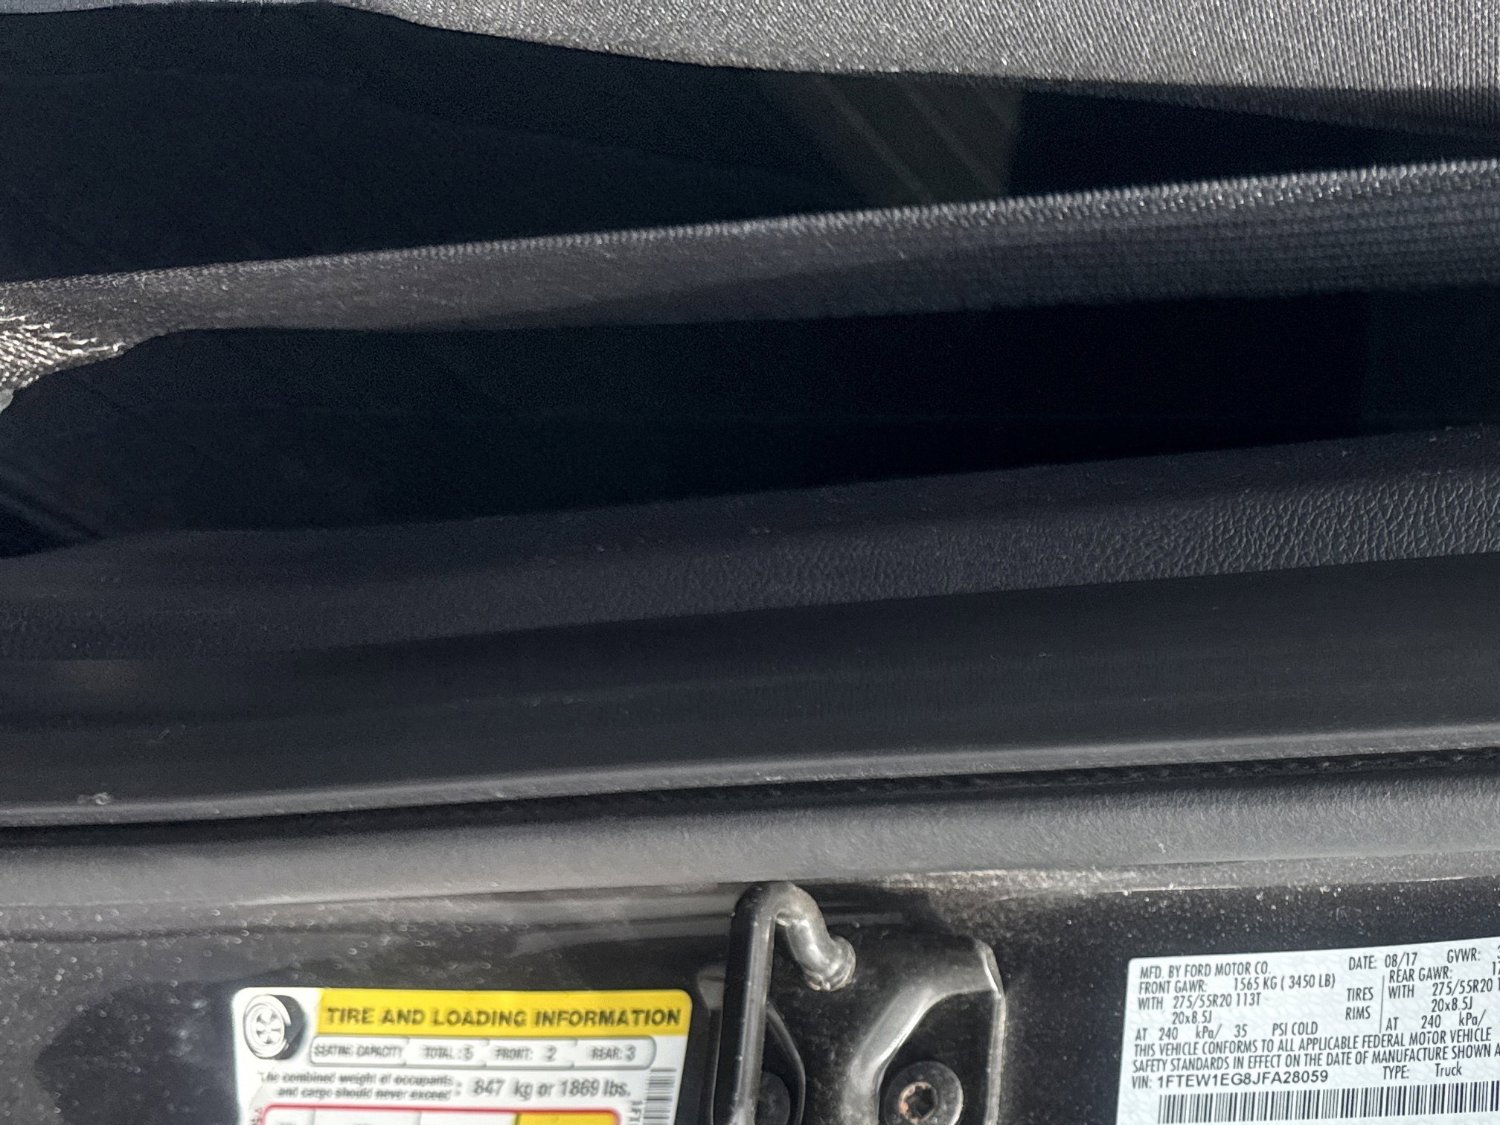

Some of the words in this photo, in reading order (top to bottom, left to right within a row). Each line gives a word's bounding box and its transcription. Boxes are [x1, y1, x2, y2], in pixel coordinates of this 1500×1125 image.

[1348, 954, 1376, 970] DATE:
[1384, 951, 1418, 968] 08/17
[1446, 947, 1480, 963] GVWR:
[1139, 965, 1164, 979] MFD.
[1167, 964, 1181, 978] BY
[1183, 962, 1211, 977] FORD
[1214, 961, 1251, 976] MOTOR
[1254, 960, 1270, 975] CO.
[1388, 966, 1414, 983] REAR
[1418, 965, 1452, 981] GAWR:
[1138, 981, 1171, 995] FRONT
[1174, 979, 1207, 993] GAWR:
[1234, 976, 1259, 991] 1565
[1262, 975, 1277, 990] KG
[1387, 983, 1414, 999] WITH
[1432, 977, 1493, 996] 275/55R20
[1137, 996, 1163, 1010] WITH
[1172, 992, 1232, 1009] 275/55R20
[1236, 991, 1261, 1006] 113T
[1430, 995, 1473, 1012] 20x8.5J
[325, 1007, 374, 1024] TIRE
[380, 1008, 425, 1025] AND
[431, 1009, 526, 1026] LOADING
[533, 1008, 681, 1027] INFORMATION
[1171, 1009, 1212, 1025] 20x8.5J
[1134, 1027, 1148, 1041] AT
[1158, 1026, 1178, 1041] 240
[1233, 1023, 1248, 1038] 35
[1271, 1022, 1288, 1036] PSI
[1291, 1020, 1318, 1036] COLD
[1133, 1043, 1155, 1057] THIS
[1158, 1041, 1199, 1056] VEHICLE
[1201, 1039, 1257, 1055] CONFORMS
[1261, 1038, 1274, 1052] TO
[1277, 1038, 1295, 1052] ALL
[1298, 1034, 1359, 1051] APPLICABLE
[1361, 1032, 1405, 1048] FEDERAL
[1408, 1029, 1446, 1046] MOTOR
[1449, 1026, 1492, 1043] VEHICLE
[1132, 1058, 1167, 1073] SAFETY
[1170, 1055, 1229, 1072] STANDARDS
[1232, 1055, 1244, 1069] IN
[1247, 1053, 1281, 1069] EFFECT
[1284, 1053, 1300, 1067] ON
[1303, 1052, 1323, 1066] THE
[1325, 1050, 1352, 1066] DATE
[1354, 1050, 1368, 1064] OF
[1371, 1045, 1449, 1064] MANUFACTURE
[1451, 1042, 1491, 1059] SHOWN
[1131, 1076, 1151, 1088] VIN:
[1157, 1069, 1328, 1088] 1FTEW1EG8JFA28059
[1382, 1064, 1409, 1080] TYPE:
[1434, 1061, 1462, 1077] Truck
[511, 1079, 533, 1098] kg
[535, 1082, 555, 1097] or
[559, 1079, 600, 1096] 1869
[601, 1080, 630, 1097] lbs.
